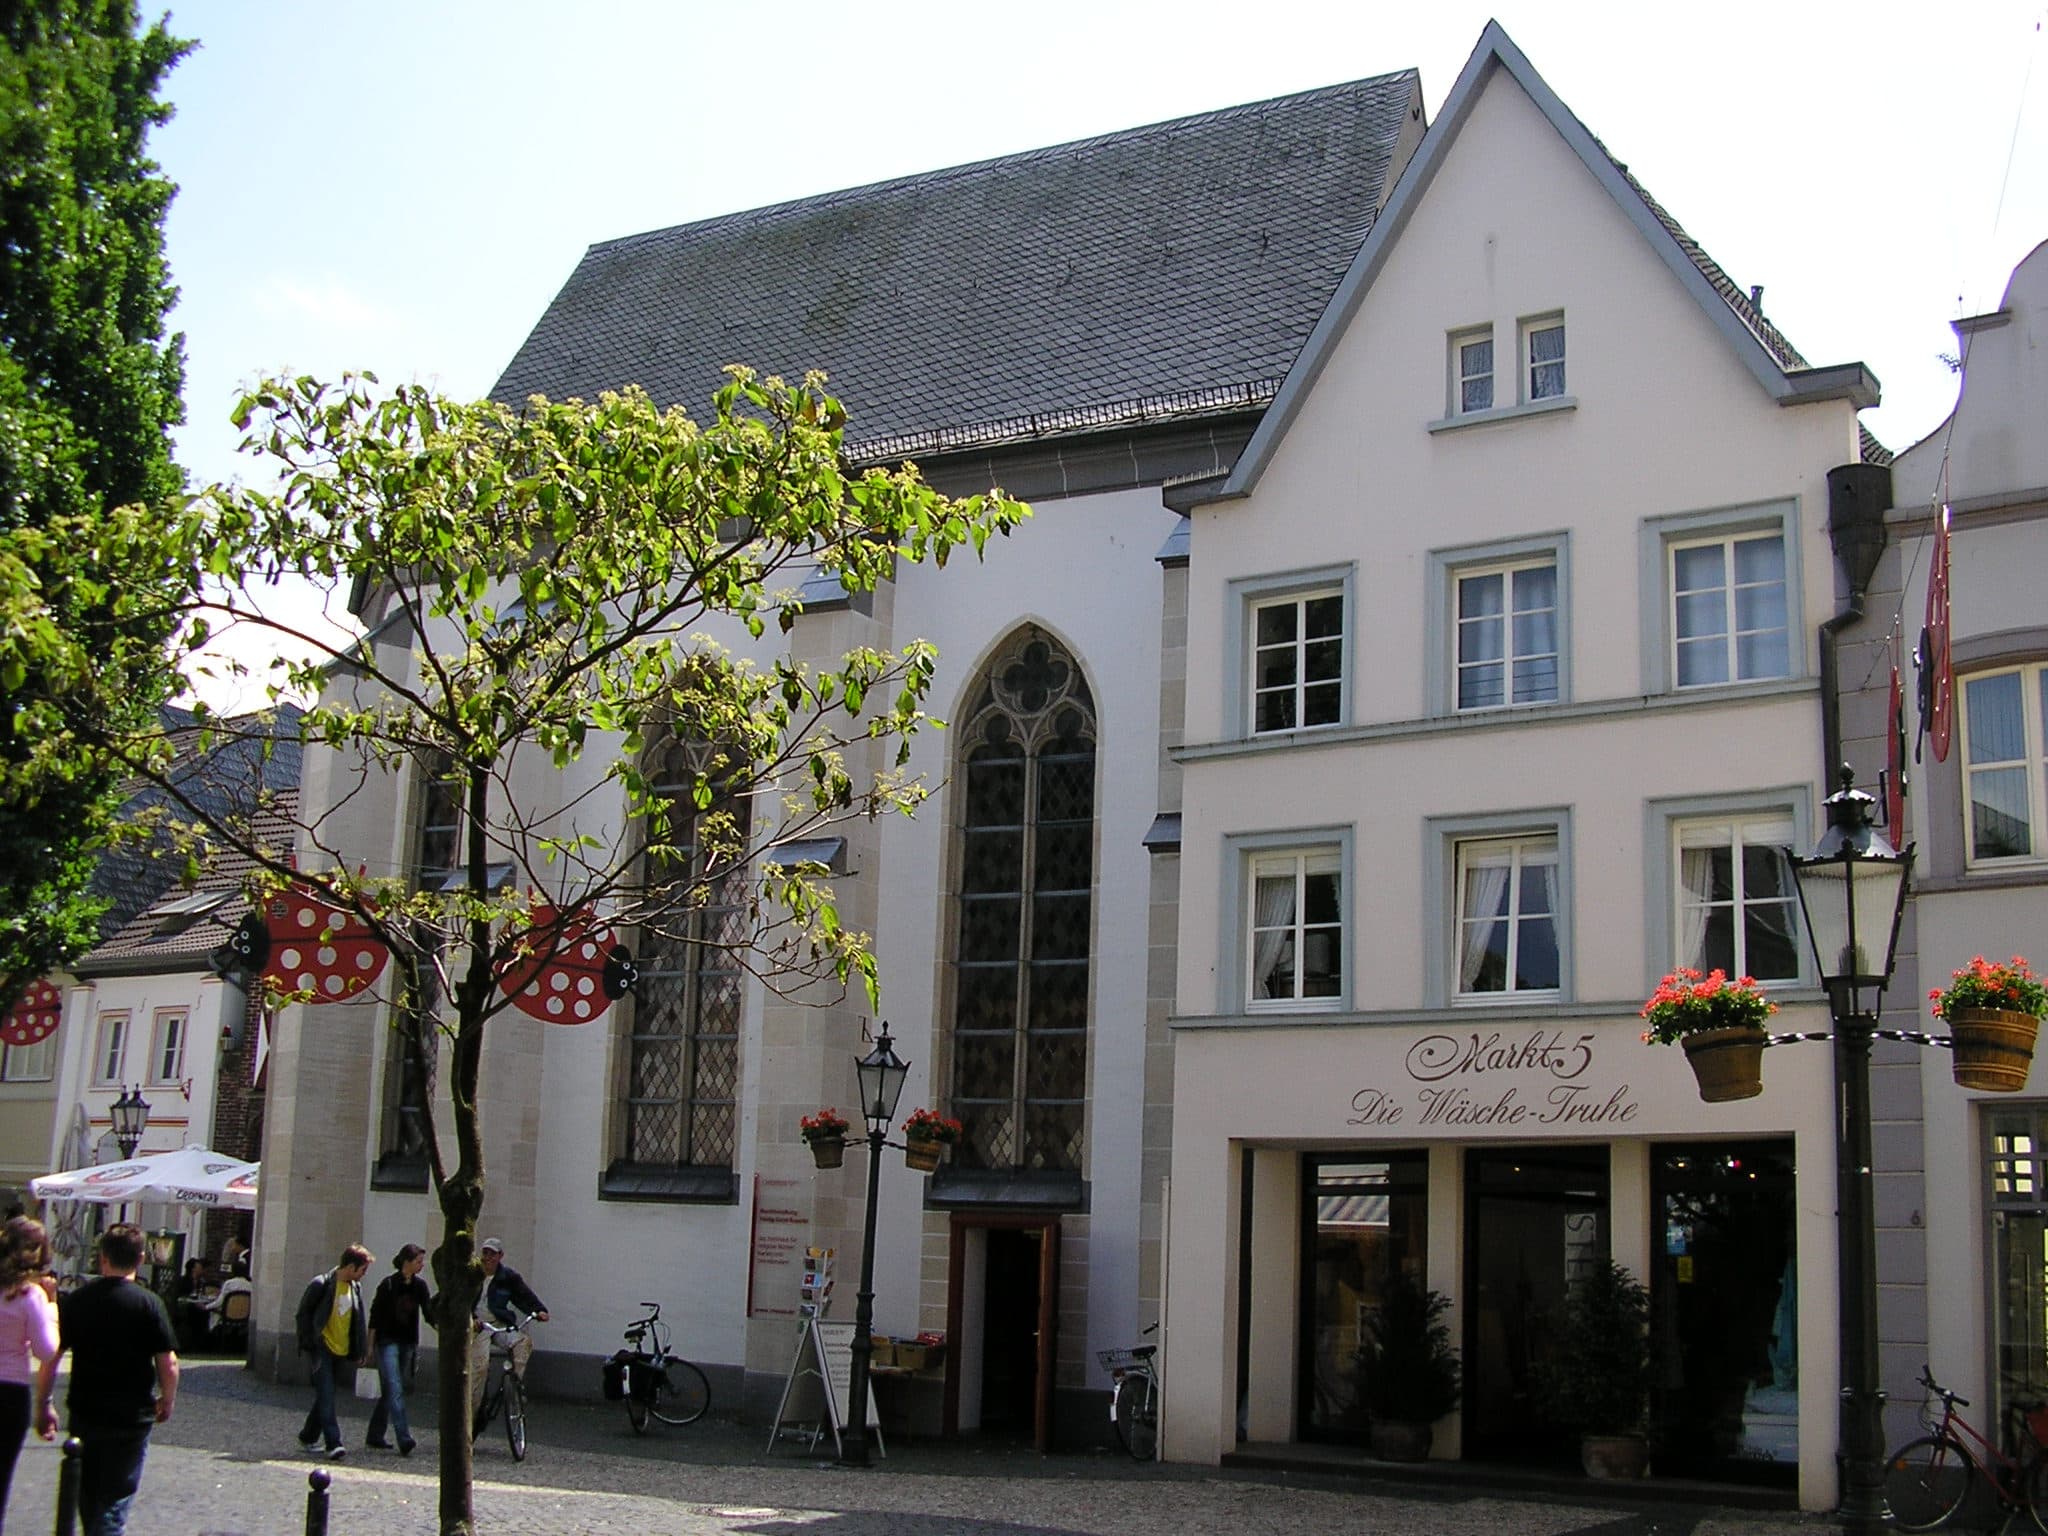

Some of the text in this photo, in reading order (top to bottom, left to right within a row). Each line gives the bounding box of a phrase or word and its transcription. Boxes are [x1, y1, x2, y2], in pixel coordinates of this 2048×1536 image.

[1406, 1030, 1595, 1081] Markt 5
[1346, 1084, 1638, 1125] Die Wäsche-Truhe
